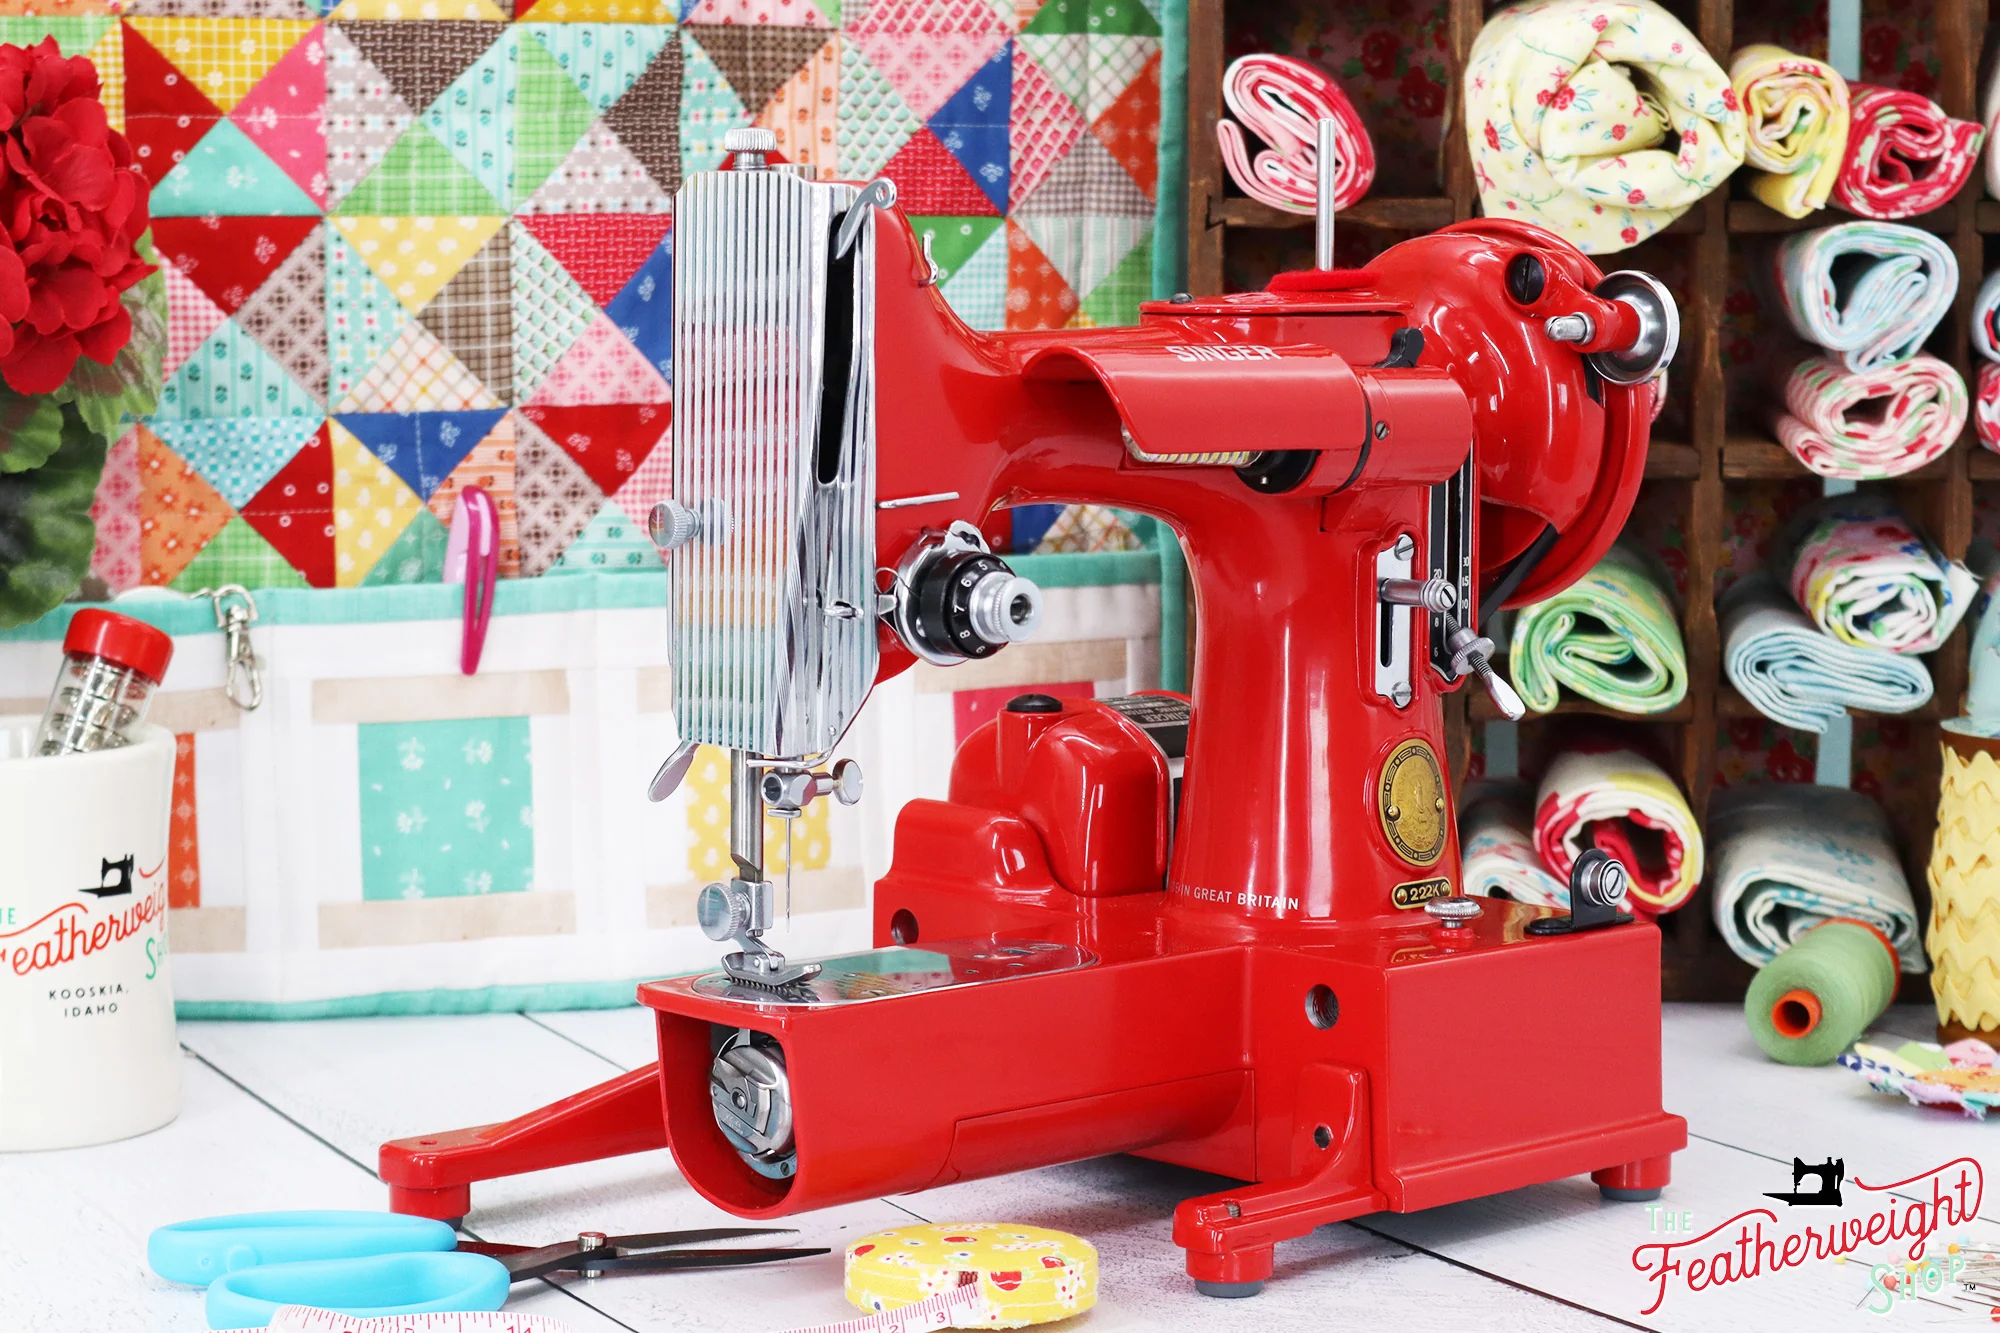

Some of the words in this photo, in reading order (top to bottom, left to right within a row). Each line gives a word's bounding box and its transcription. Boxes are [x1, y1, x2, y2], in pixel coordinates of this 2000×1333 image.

[1165, 345, 1282, 362] SINGER
[977, 561, 988, 571] 5
[1433, 568, 1442, 579] 20
[960, 578, 972, 587] 6
[954, 605, 965, 613] 7
[960, 630, 970, 639] 8
[1410, 883, 1440, 901] 222K
[1194, 886, 1233, 904] GREAT
[1237, 891, 1299, 911] BRITAIN
[49, 983, 129, 1000] KOOSKIA,
[64, 1002, 118, 1017] IDAHO
[935, 1312, 945, 1323] 3
